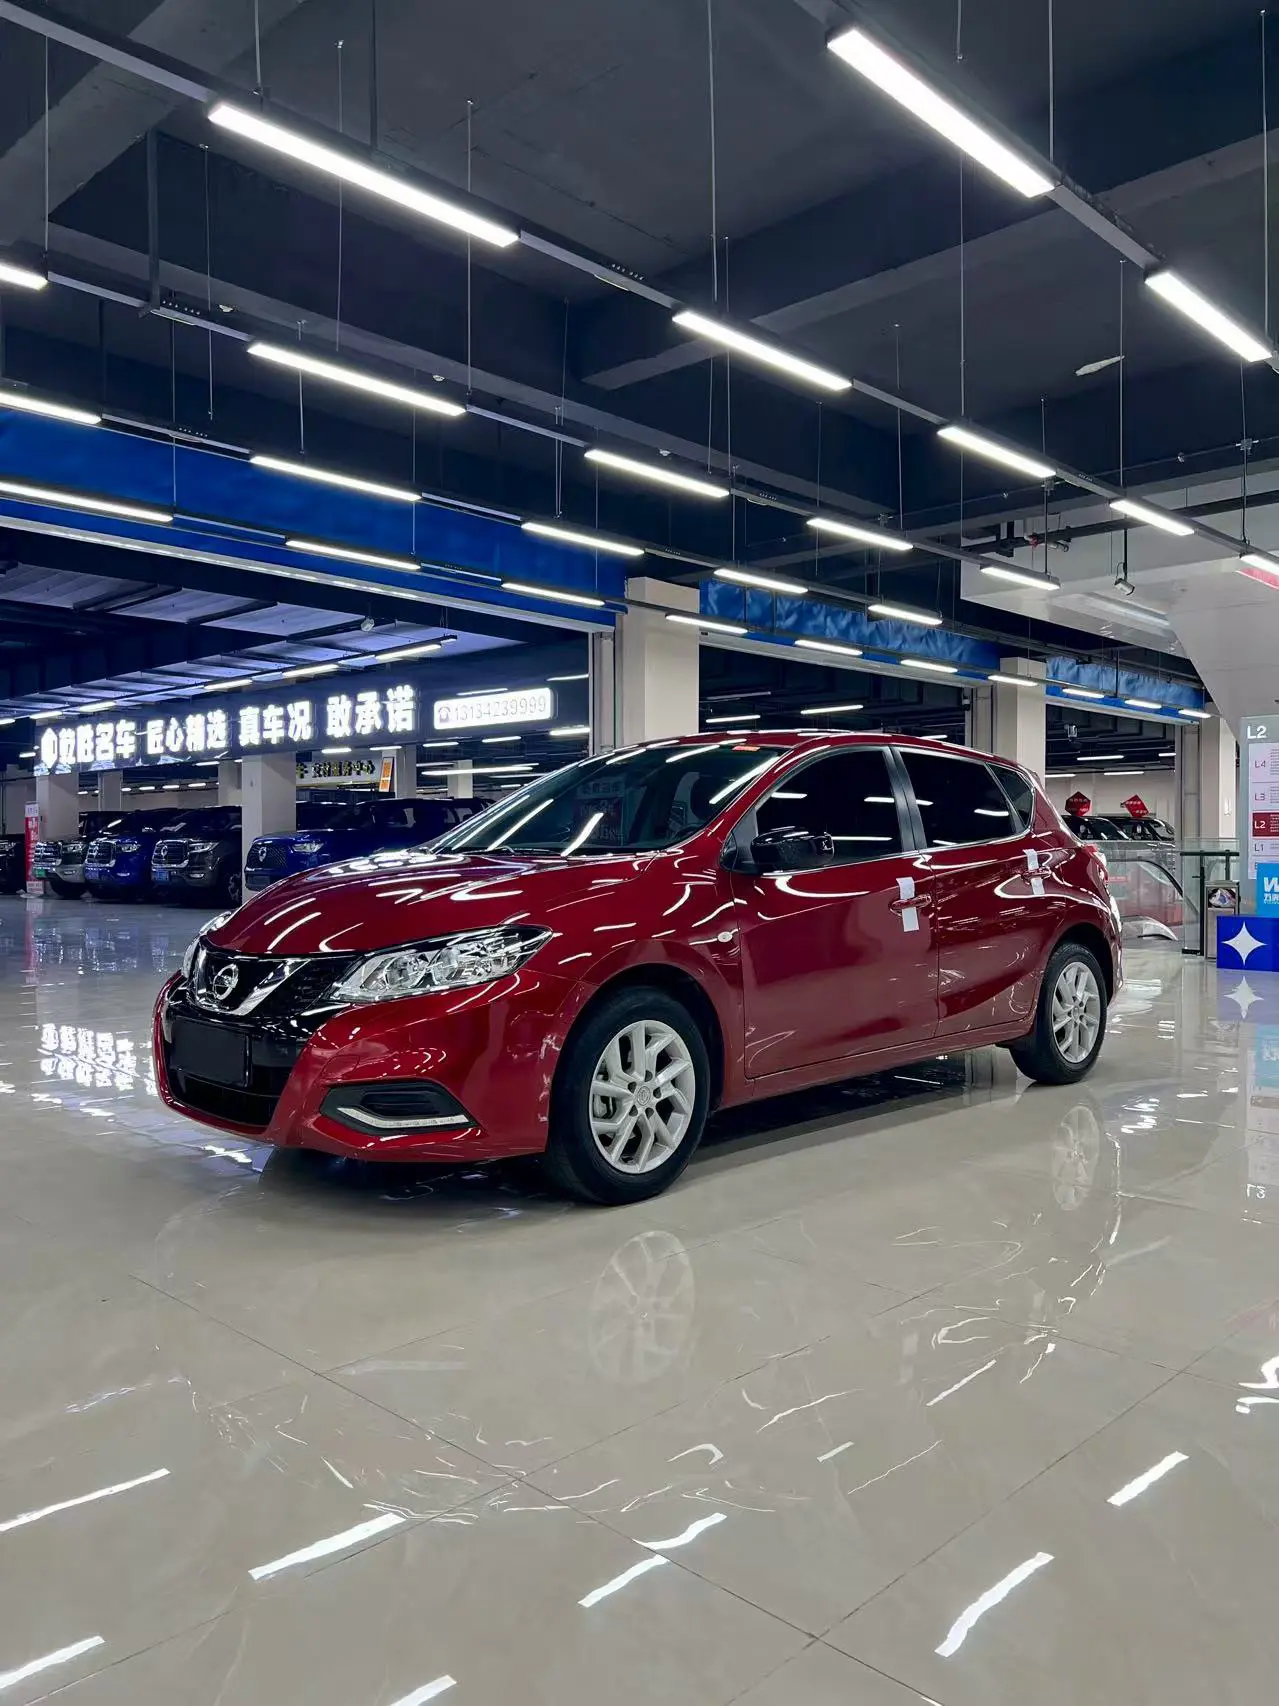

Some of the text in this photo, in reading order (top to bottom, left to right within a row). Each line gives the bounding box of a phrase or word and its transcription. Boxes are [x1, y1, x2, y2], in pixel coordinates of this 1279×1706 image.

[147, 709, 227, 755] 匠心精选
[238, 700, 312, 746] 真车况
[326, 684, 415, 738] 敢承诺
[1246, 725, 1267, 740] L2
[1254, 760, 1266, 769] L4
[1254, 792, 1266, 801] L3
[1254, 820, 1266, 829] L2
[1254, 844, 1264, 852] L1
